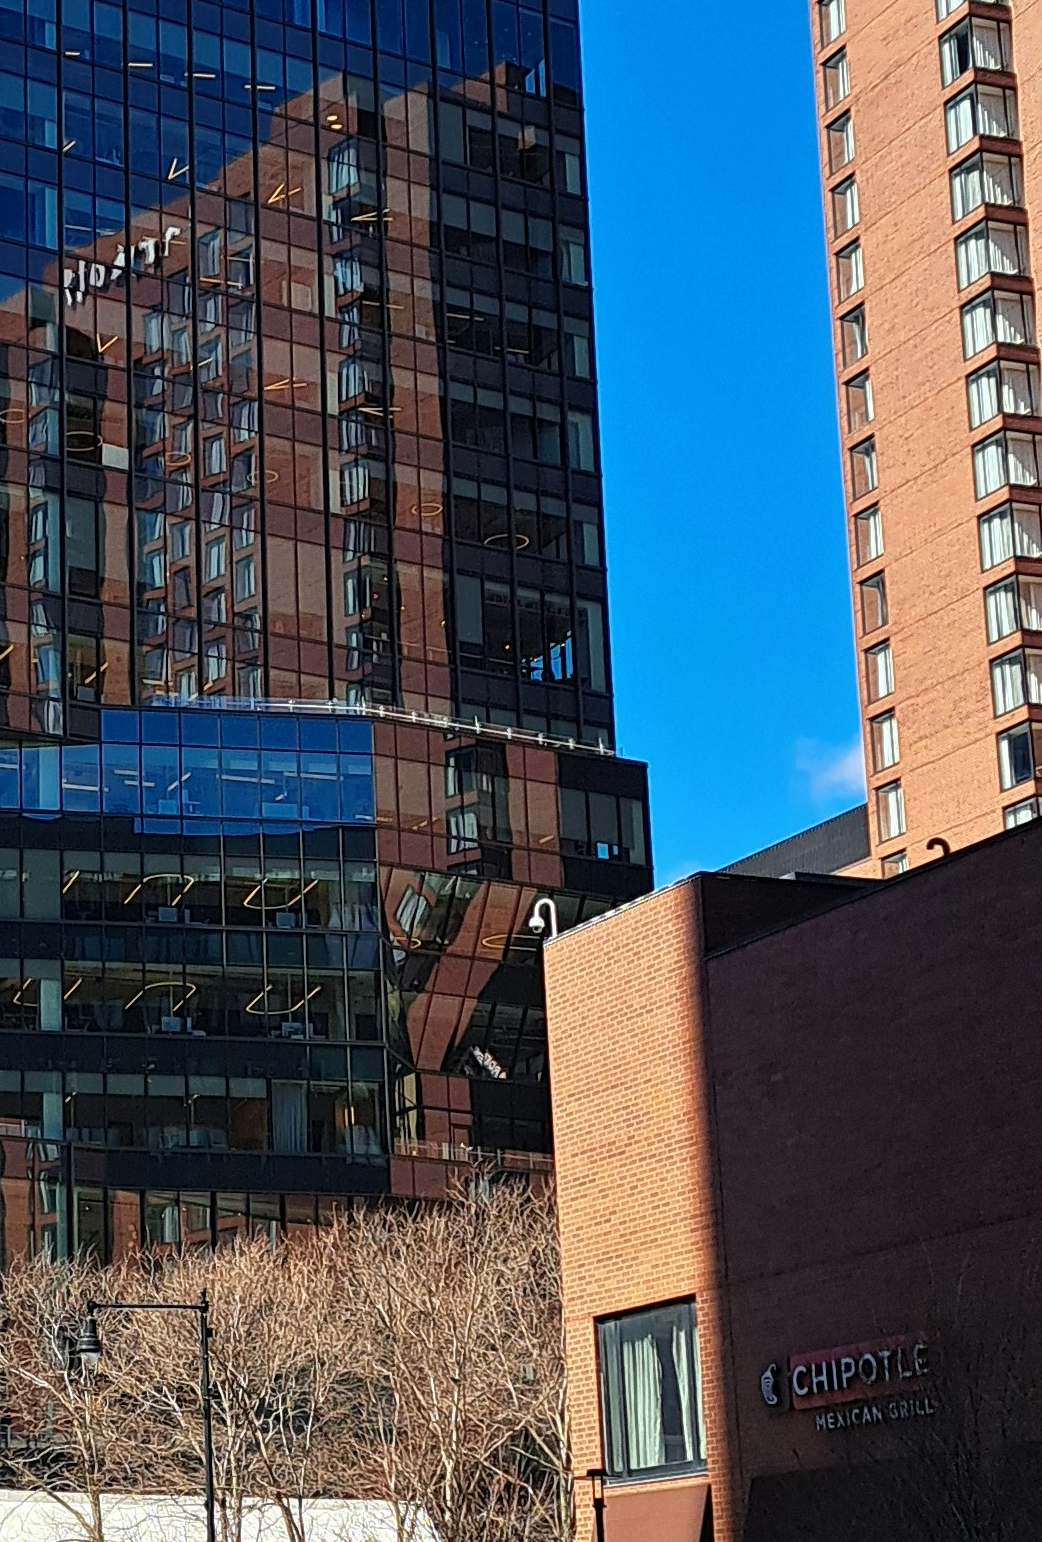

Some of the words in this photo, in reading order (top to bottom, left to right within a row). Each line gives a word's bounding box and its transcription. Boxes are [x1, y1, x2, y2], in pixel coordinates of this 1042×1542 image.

[792, 1342, 929, 1396] CHIPOTLE
[815, 1404, 882, 1431] MEXICAN
[888, 1398, 935, 1420] GRILL
